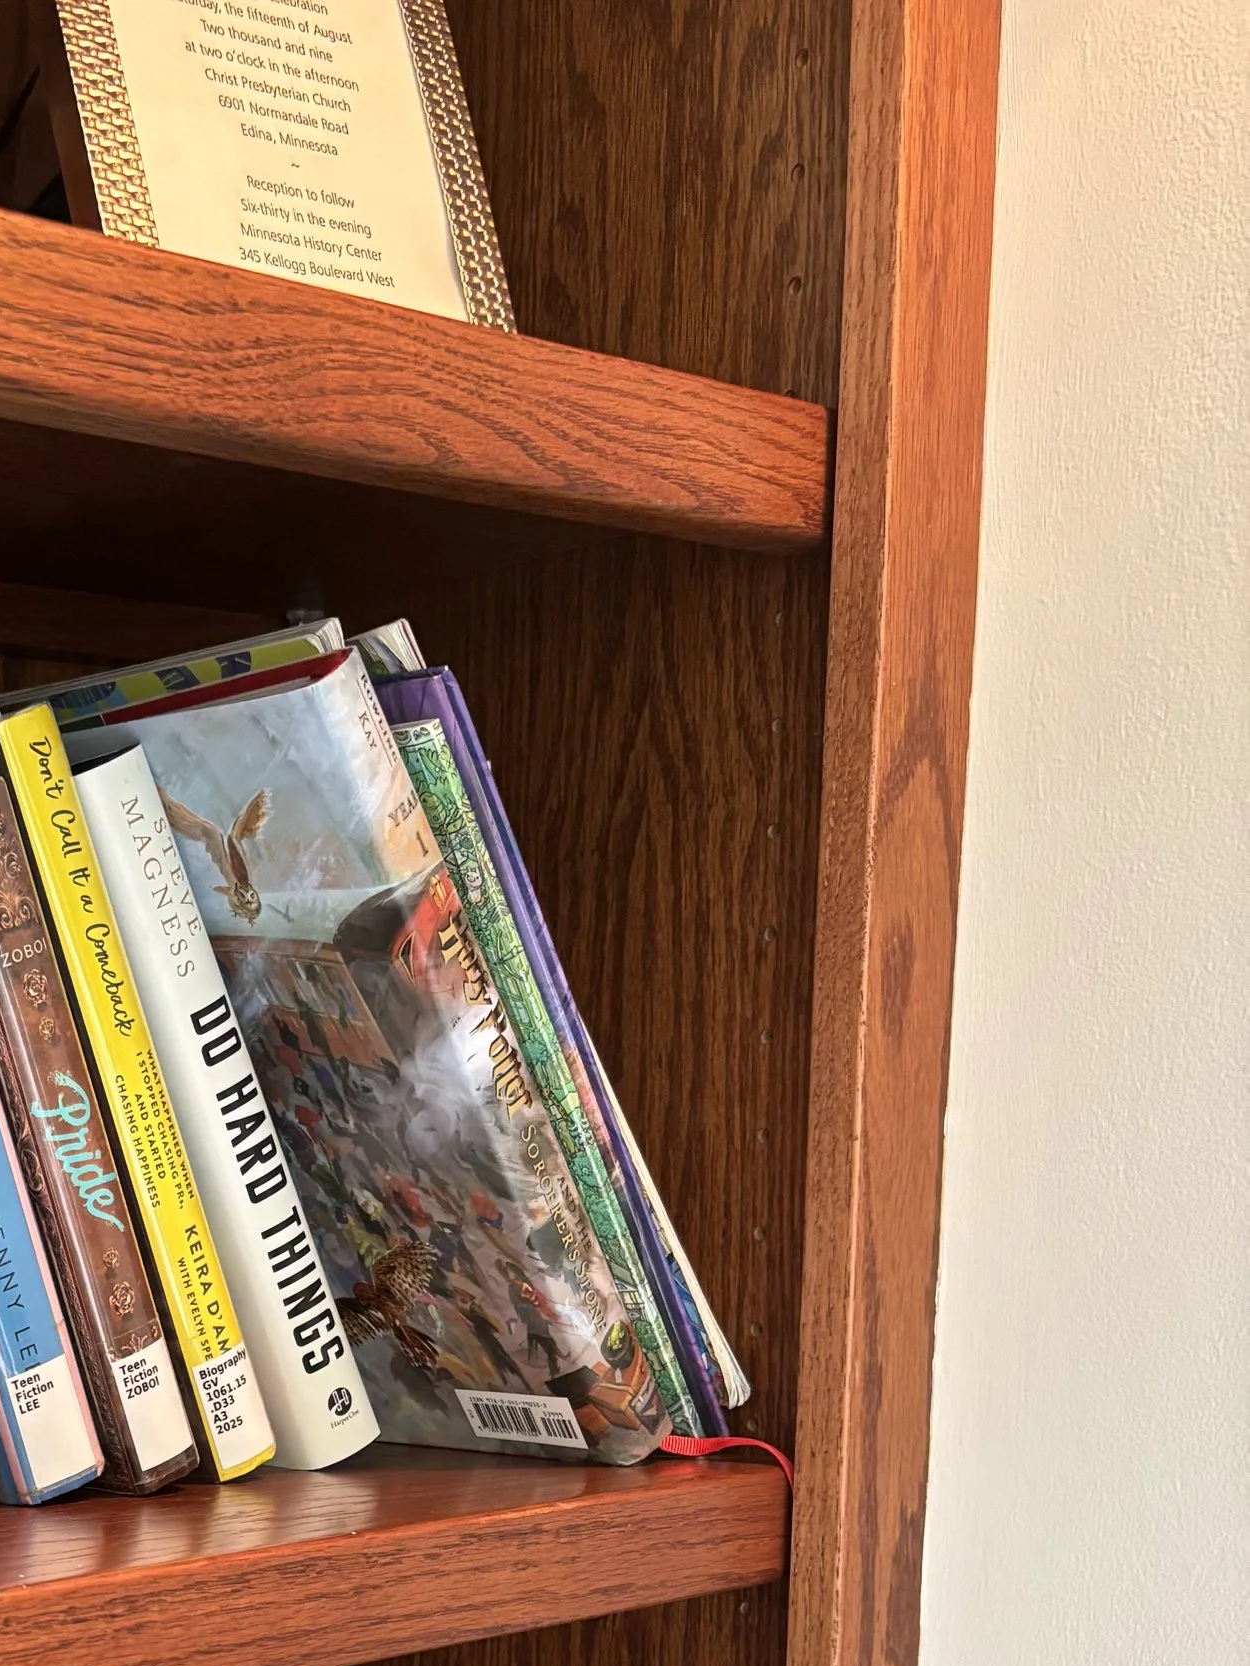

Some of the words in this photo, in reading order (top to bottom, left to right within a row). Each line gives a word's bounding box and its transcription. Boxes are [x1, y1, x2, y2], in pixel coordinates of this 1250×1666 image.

[224, 2, 244, 17] the
[247, 6, 295, 30] fifteenth
[298, 21, 309, 34] of
[314, 24, 353, 44] August
[200, 18, 225, 36] Two
[228, 26, 282, 50] thousand
[285, 41, 306, 56] and
[309, 46, 333, 63] nine
[204, 68, 238, 87] Christ
[241, 75, 309, 103] Presbyterian
[312, 93, 351, 113] Church
[240, 123, 277, 145] Edina,
[279, 131, 338, 156] Minnesota
[246, 175, 303, 198] Reception
[305, 188, 318, 202] to
[321, 189, 355, 209] follow
[240, 222, 301, 247] Minnesota
[303, 235, 343, 258] History
[346, 243, 383, 262] Center
[239, 247, 262, 263] 345
[264, 252, 306, 275] Kellogg
[309, 261, 364, 282] Boulevard
[366, 270, 396, 288] West
[121, 794, 196, 979] MAGNESS
[153, 816, 204, 938] STEVE
[0, 940, 48, 969] ZOBOI
[190, 993, 248, 1068] DO
[30, 1066, 125, 1232] Pride
[134, 1093, 149, 1121] AND
[144, 1124, 166, 1180] STARTED
[216, 1072, 287, 1204] HARD
[261, 1206, 345, 1375] THINGS
[120, 1357, 146, 1375] Teen
[123, 1364, 158, 1388] Fiction
[199, 1348, 247, 1381] Biography
[12, 1373, 41, 1390] Teen
[16, 1380, 54, 1402] Fiction
[126, 1379, 159, 1399] ZOBOI
[202, 1377, 220, 1391] GV
[206, 1374, 247, 1402] 1061.15
[19, 1398, 41, 1414] LEE
[210, 1394, 236, 1413] .D33
[213, 1411, 228, 1425] A3
[216, 1415, 244, 1435] 2025
